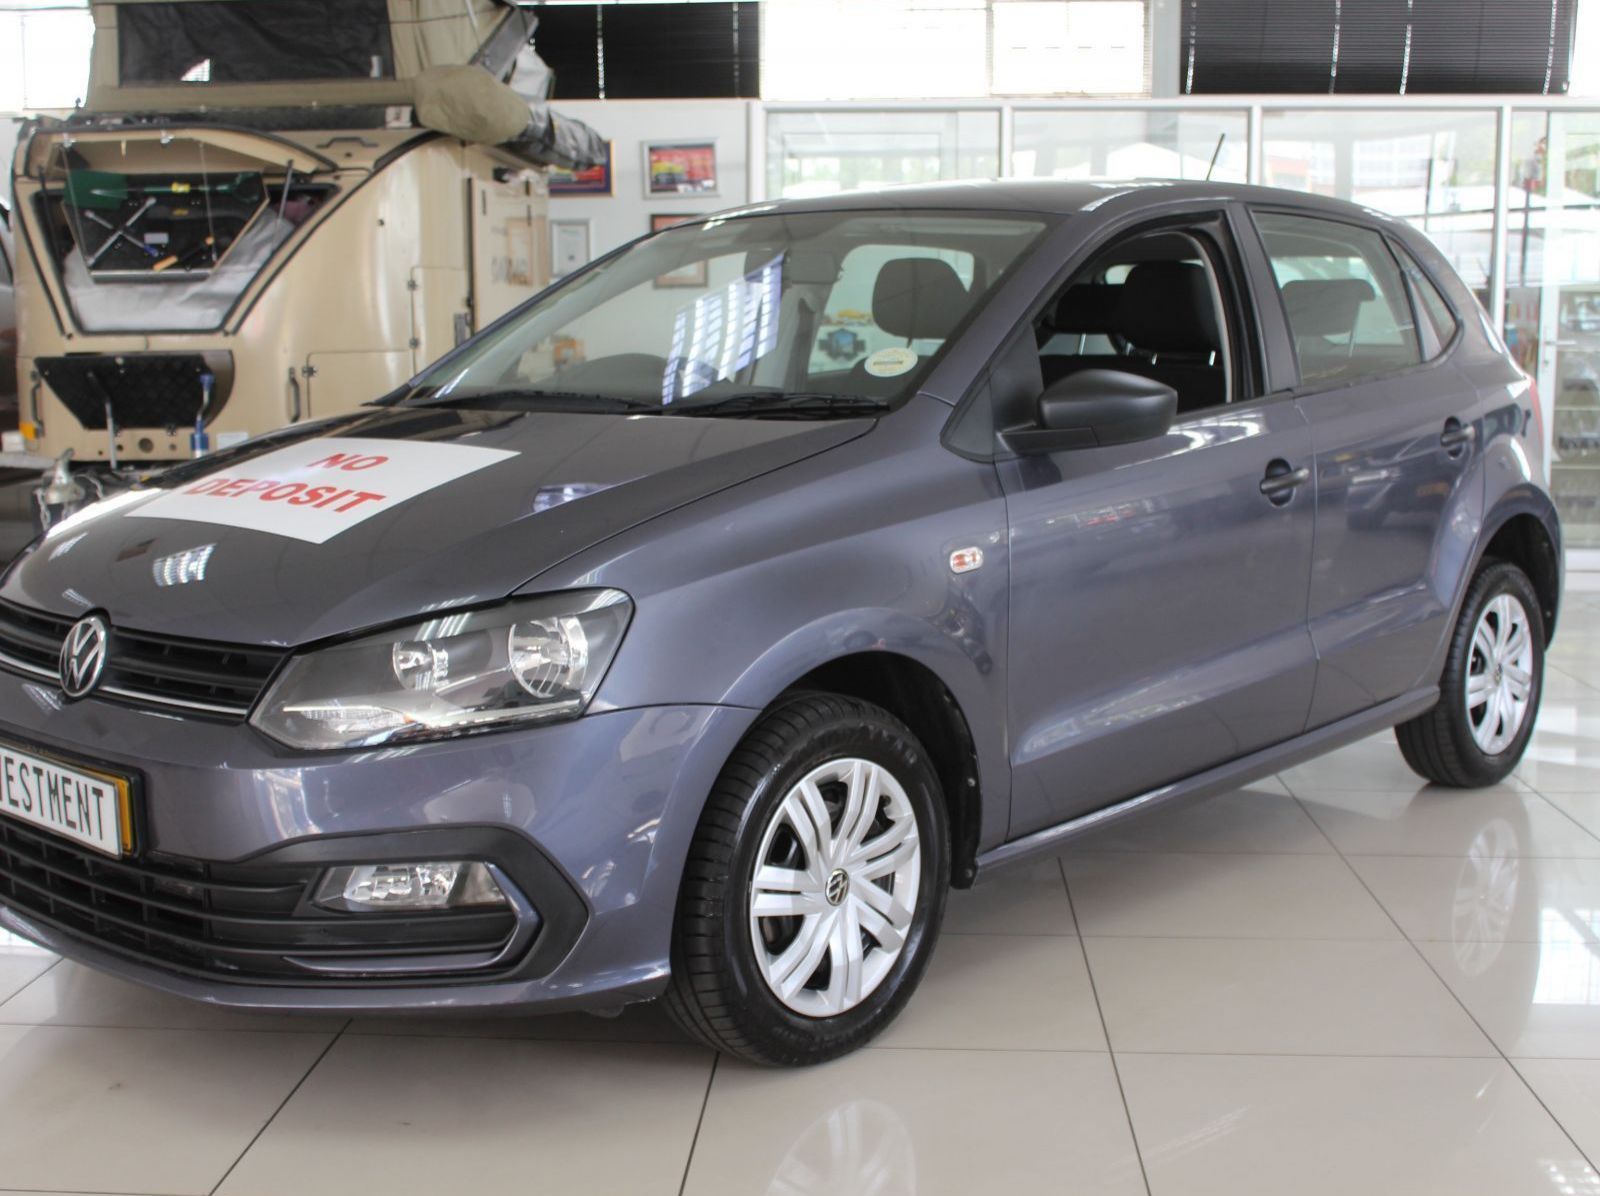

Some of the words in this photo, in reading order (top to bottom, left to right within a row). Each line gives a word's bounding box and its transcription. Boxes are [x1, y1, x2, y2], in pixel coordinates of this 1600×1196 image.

[306, 453, 389, 471] NO
[183, 478, 387, 512] DEPOSIT
[0, 755, 104, 841] ESTMENT
